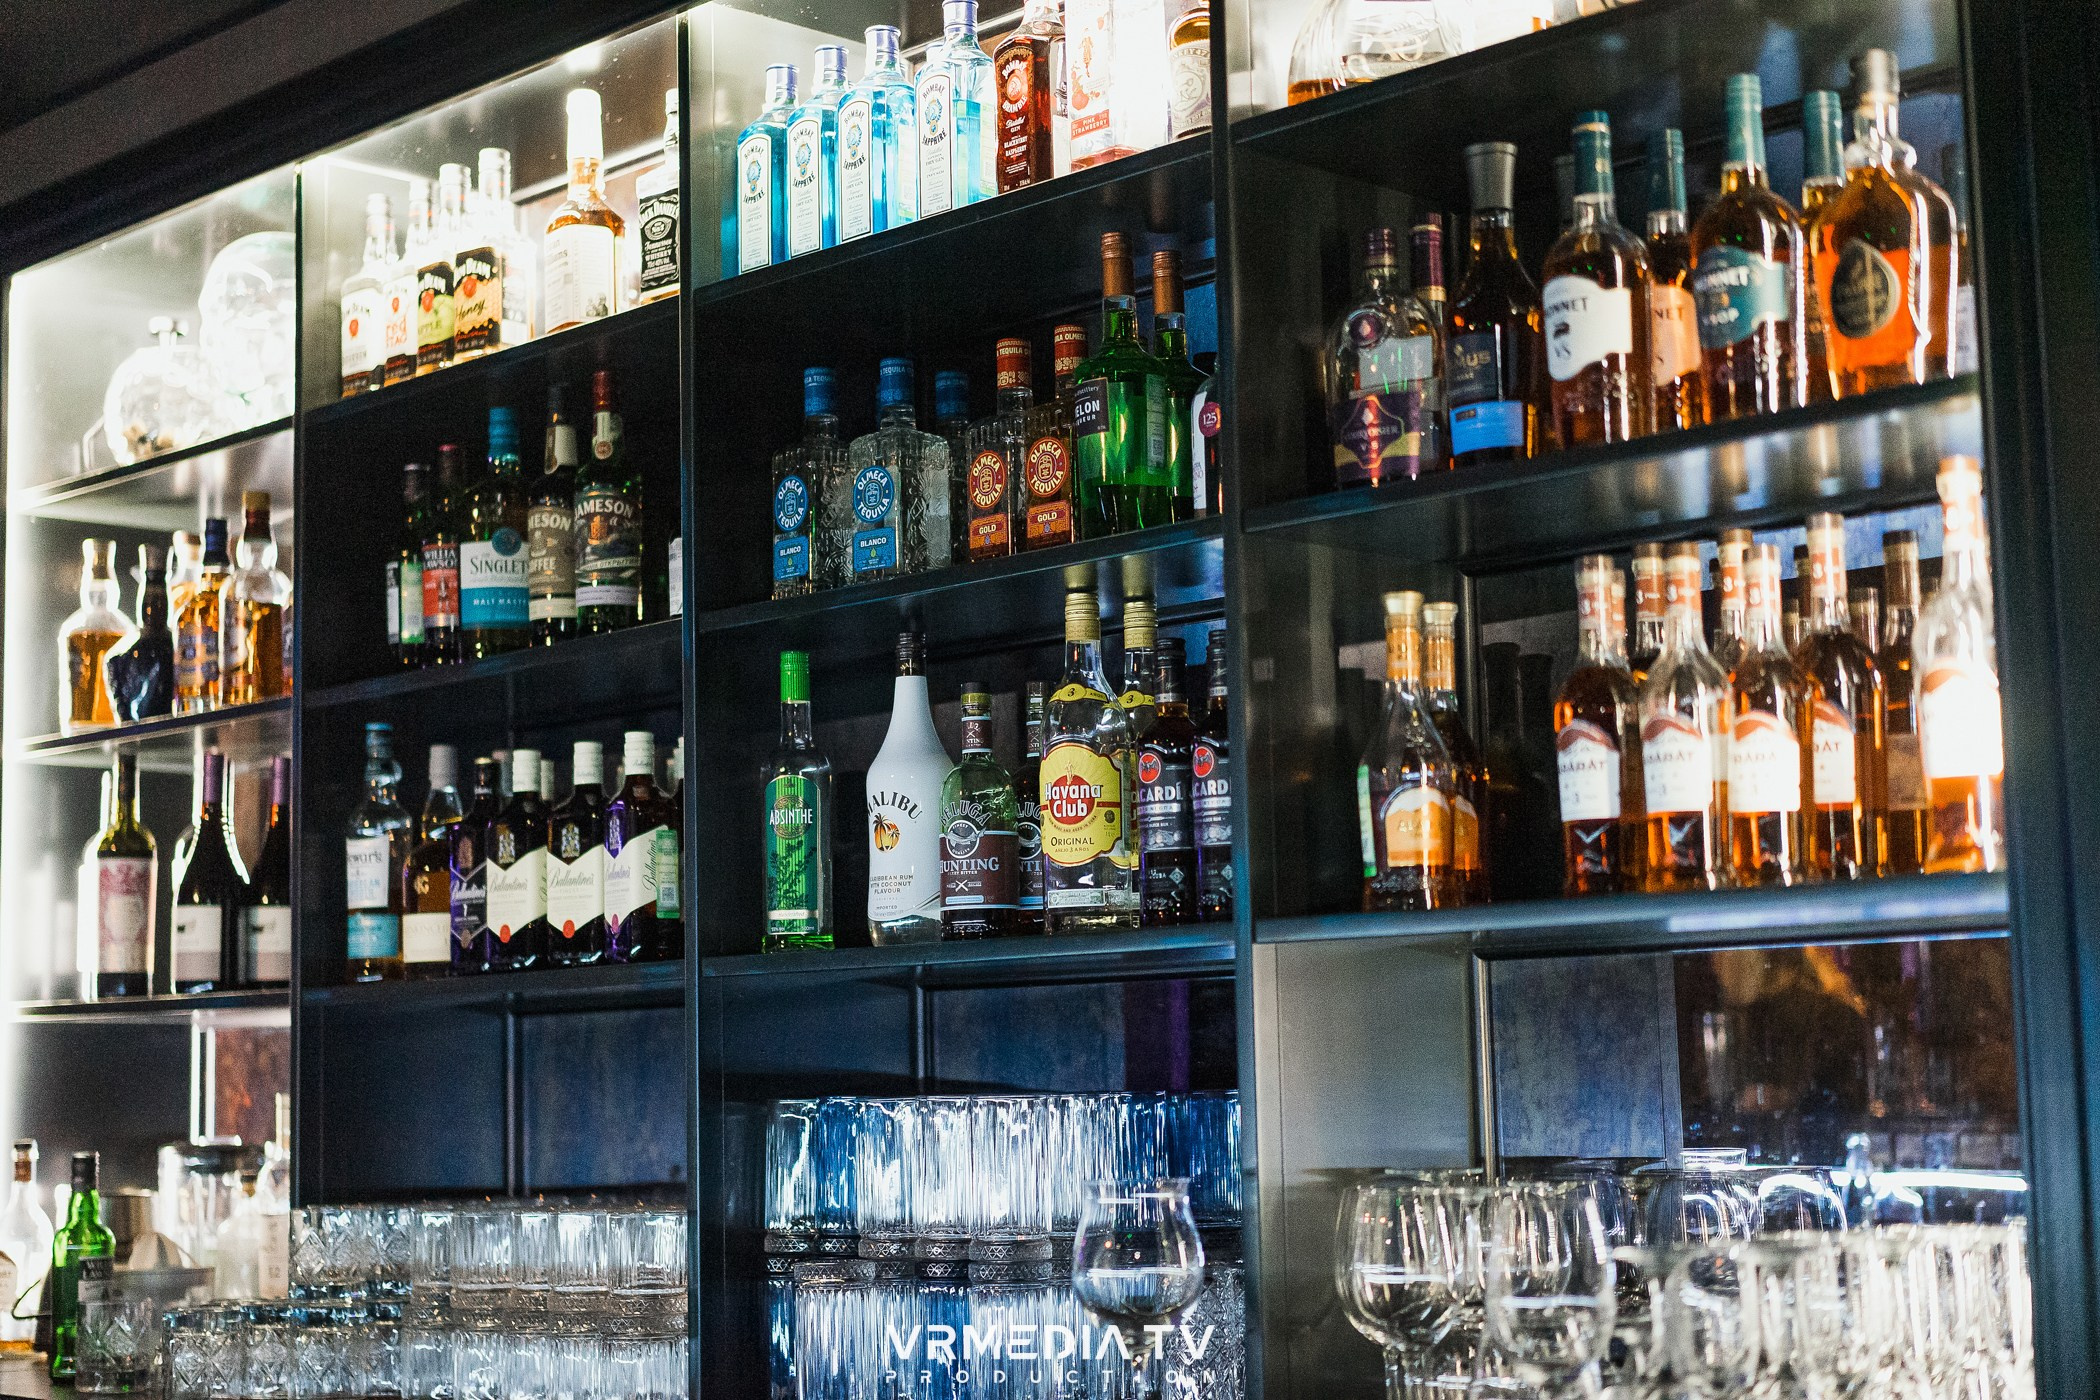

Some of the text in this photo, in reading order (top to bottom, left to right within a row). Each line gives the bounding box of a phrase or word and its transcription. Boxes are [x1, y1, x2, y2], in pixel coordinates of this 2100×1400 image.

[1002, 60, 1027, 79] BOMBAY
[923, 83, 946, 100] BOMBAY
[1002, 95, 1028, 114] BRAMBLE
[844, 109, 864, 124] BOMBAY
[1083, 116, 1096, 126] PINK
[793, 128, 814, 143] BOMBAY
[1072, 119, 1107, 136] STRAWBERRY
[922, 128, 947, 146] SAPPHIRE
[744, 145, 764, 160] BOMBAY
[843, 153, 866, 170] SAPPHIRE
[792, 170, 815, 188] SAPPHIRE
[743, 187, 764, 204] SAPPHIRE
[645, 250, 672, 261] WHISKEY
[456, 299, 486, 320] Honey
[1000, 348, 1023, 356] TEQUILA
[1075, 400, 1100, 418] ELON
[1202, 412, 1217, 426] 125
[1030, 441, 1062, 464] OLMECA
[972, 456, 1001, 476] OLMECA
[778, 480, 803, 499] OLMECA
[857, 470, 888, 491] OLMECA
[1030, 470, 1064, 494] TEQUILA
[973, 483, 1002, 508] TEQUILA
[574, 499, 633, 522] JAMESON
[856, 497, 890, 518] TEQUILA
[778, 507, 804, 530] TEQUILA
[1037, 512, 1058, 523] GOLD
[979, 523, 997, 534] GOLD
[780, 546, 802, 557] BLANCO
[860, 537, 887, 548] BLANCO
[471, 556, 529, 575] SINGLET
[1068, 687, 1075, 698] 3
[1126, 694, 1134, 704] 3
[1046, 782, 1102, 801] Havana
[1140, 782, 1184, 802] CARDÍ
[770, 808, 813, 826] ABSINTHE
[940, 800, 994, 827] BELUGA
[1054, 799, 1088, 818] Club
[1051, 836, 1094, 846] ORIGINAL
[550, 868, 594, 888] Ballantine's
